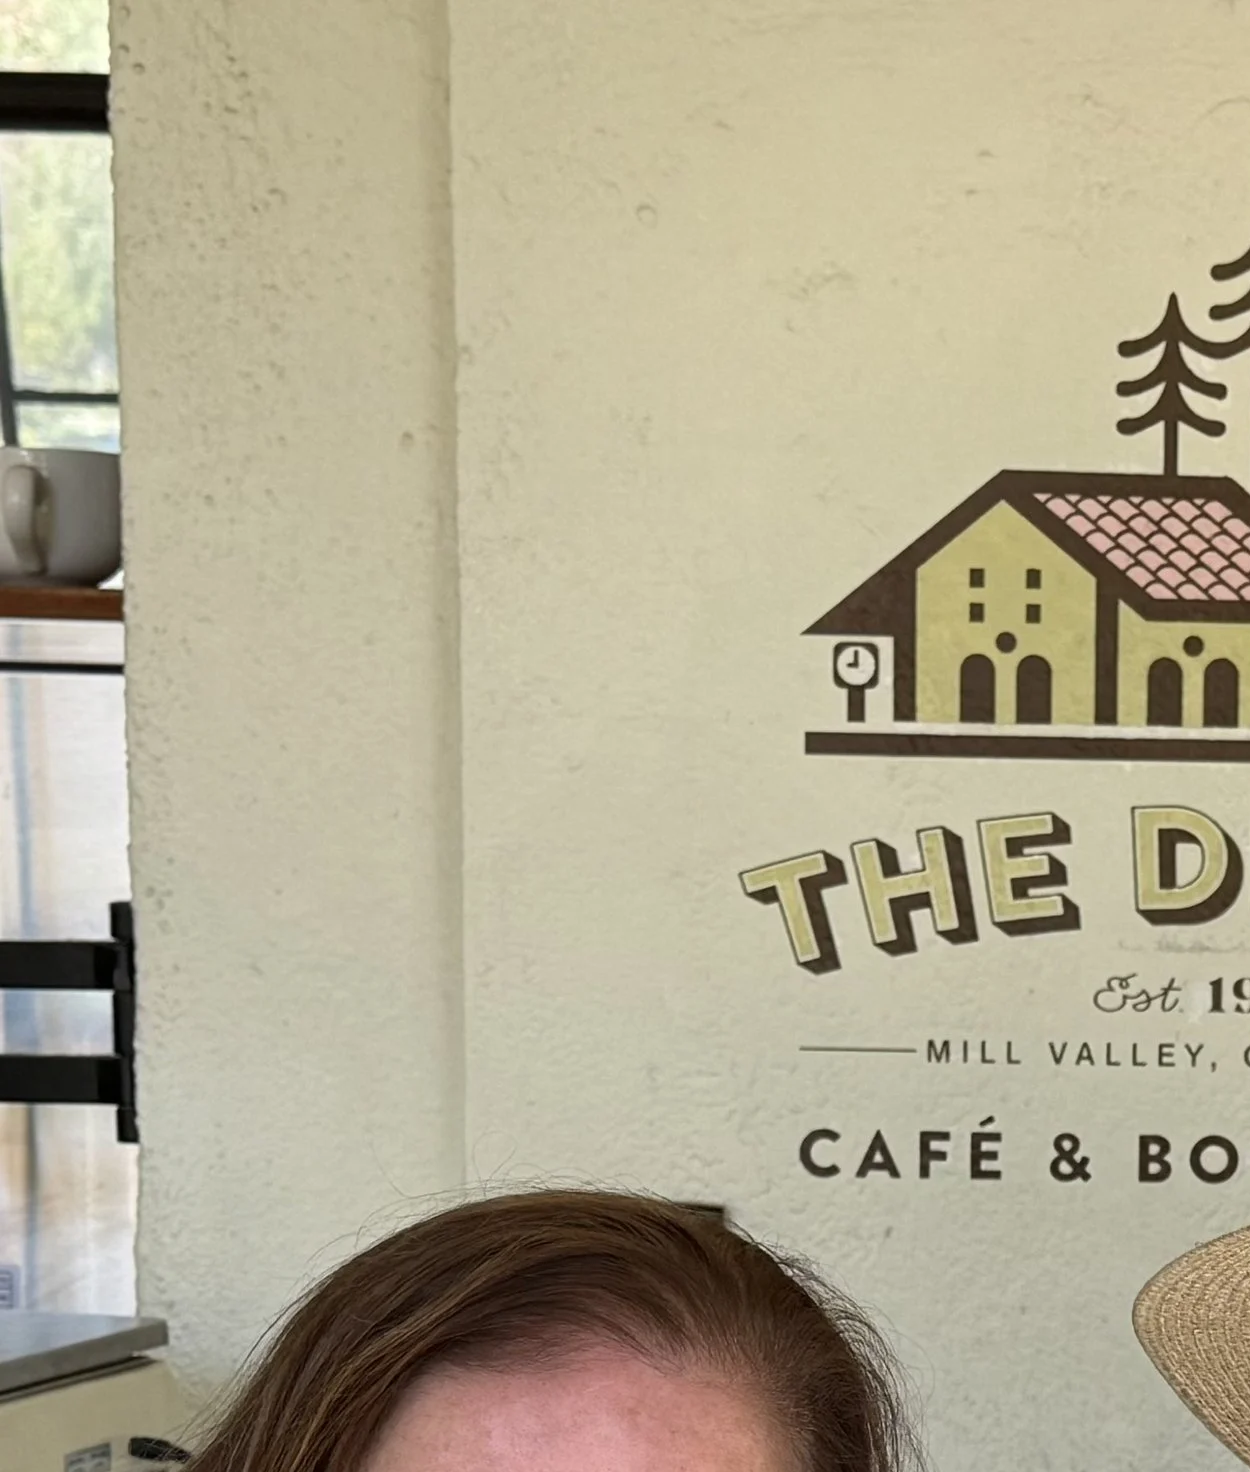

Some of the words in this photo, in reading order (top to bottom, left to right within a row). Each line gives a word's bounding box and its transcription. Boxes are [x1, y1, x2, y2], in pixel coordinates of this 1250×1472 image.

[739, 812, 1081, 975] THE
[927, 1039, 1021, 1065] MILL
[1048, 1041, 1217, 1073] VALLEY,
[799, 1115, 1002, 1180] CAFÉ
[1049, 1132, 1092, 1183] &
